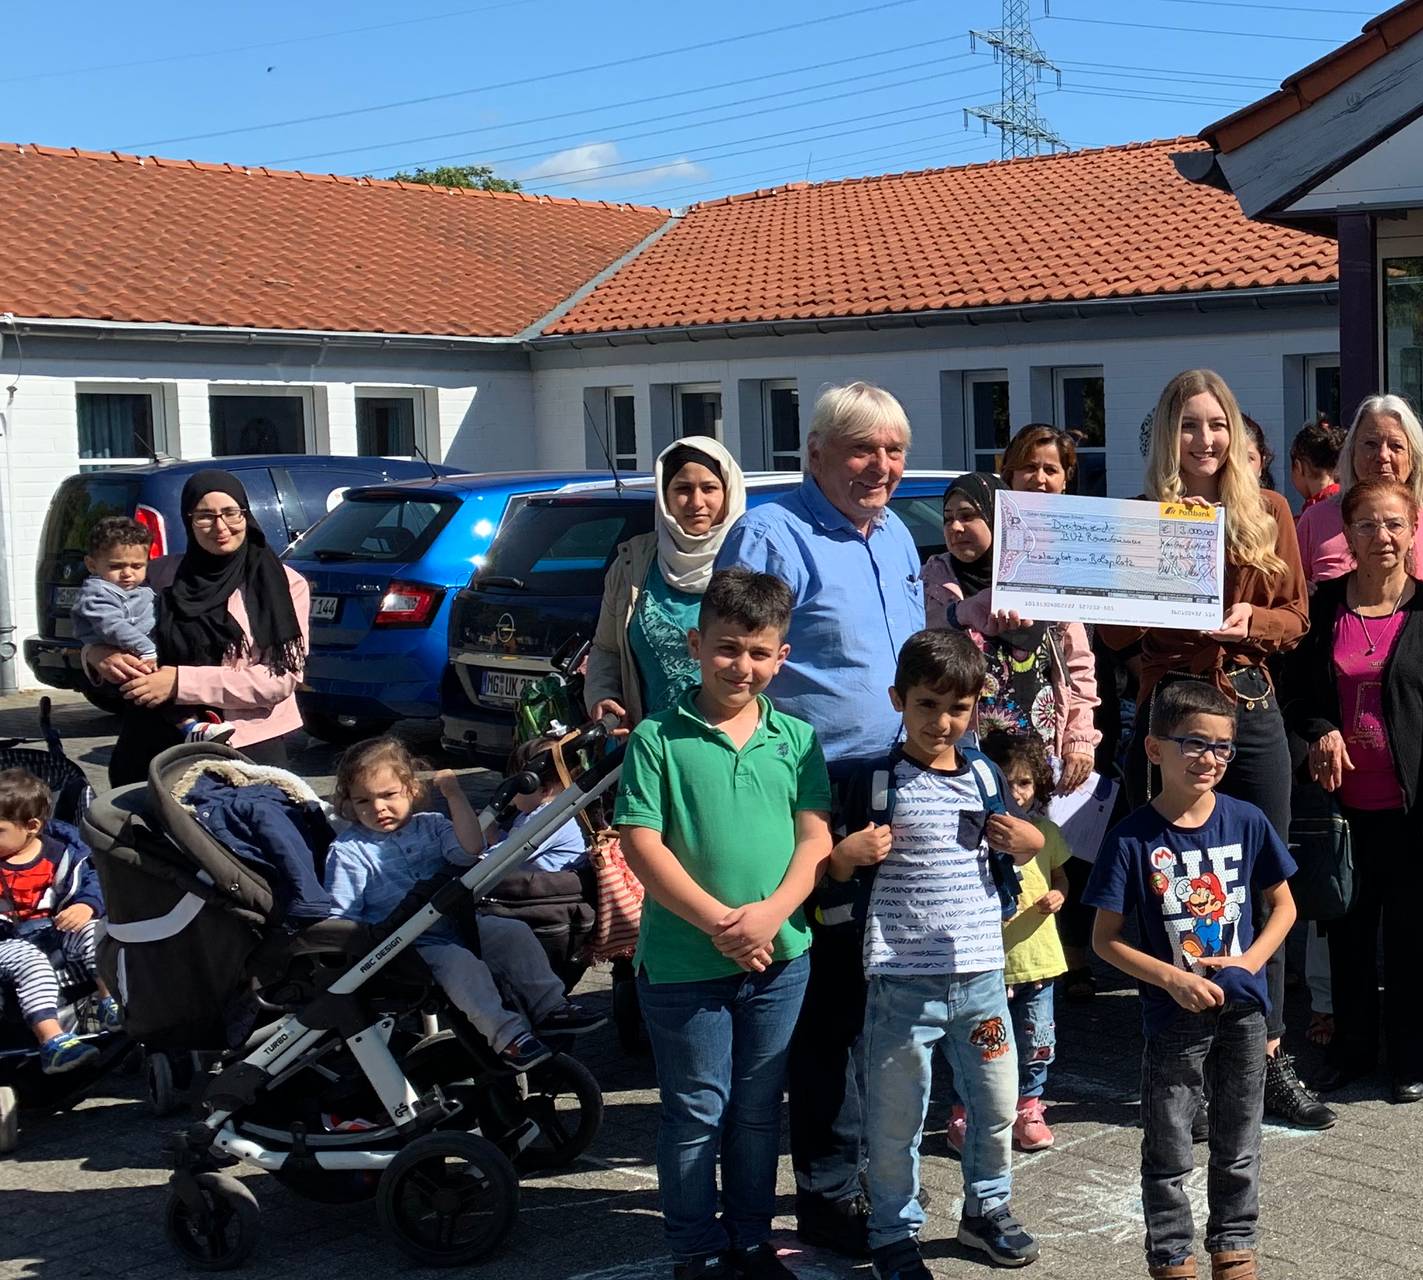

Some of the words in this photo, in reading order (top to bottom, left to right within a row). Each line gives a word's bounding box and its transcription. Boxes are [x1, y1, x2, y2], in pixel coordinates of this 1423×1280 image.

[1179, 509, 1210, 517] Postbank
[487, 674, 499, 694] MG
[505, 676, 518, 697] UK
[360, 957, 377, 974] ABC
[375, 935, 403, 961] DESIGN
[263, 1033, 289, 1056] TURBO
